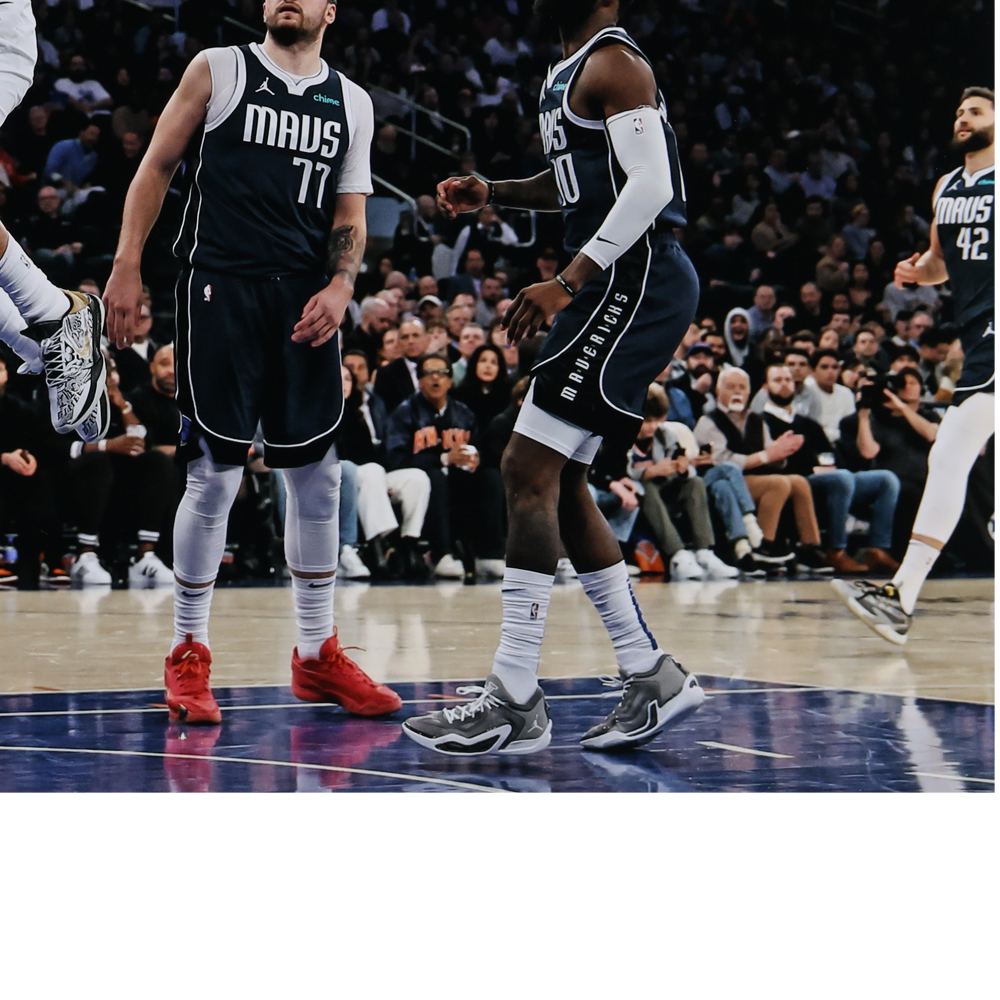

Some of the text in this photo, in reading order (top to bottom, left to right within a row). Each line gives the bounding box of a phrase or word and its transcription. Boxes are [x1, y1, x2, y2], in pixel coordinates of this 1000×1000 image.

[312, 93, 340, 107] chime
[243, 103, 341, 159] MAVS
[292, 156, 331, 209] 77
[935, 194, 994, 225] MAVS
[956, 227, 989, 260] 42
[560, 292, 629, 402] MAVERICKS
